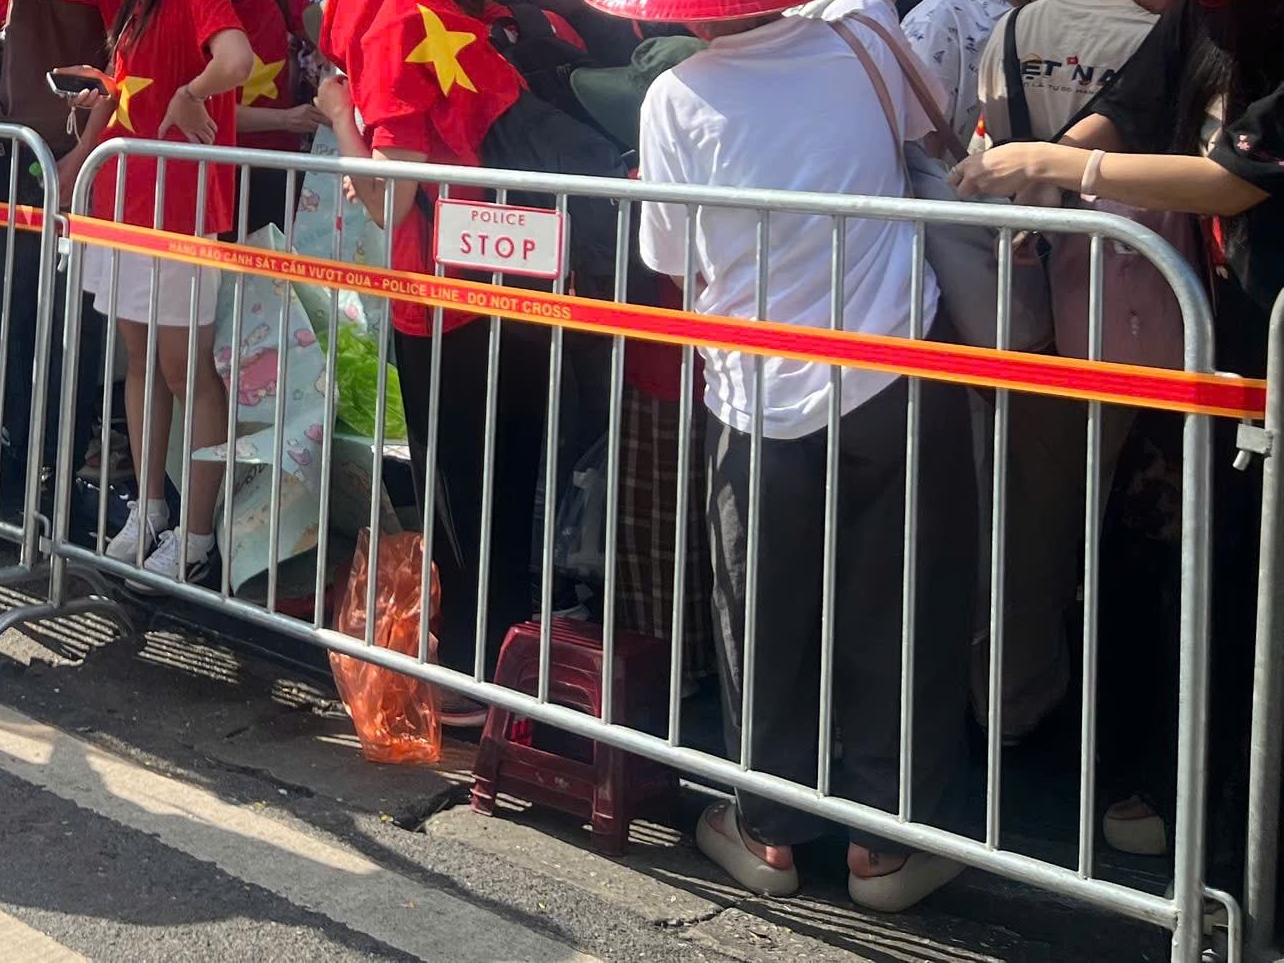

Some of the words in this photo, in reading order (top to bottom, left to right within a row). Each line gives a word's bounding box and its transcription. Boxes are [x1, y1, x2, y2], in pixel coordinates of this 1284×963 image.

[471, 210, 525, 226] POLICE
[459, 231, 536, 261] STOP
[169, 240, 197, 258] HÀNG
[199, 245, 223, 262] RÀO
[224, 249, 253, 266] CẢNH
[280, 256, 306, 276] CẤM
[308, 266, 344, 283] VƯỢT
[346, 272, 372, 288] QUA
[382, 278, 427, 297] POLICE
[467, 292, 487, 306] DO
[490, 295, 518, 311] NOT
[522, 301, 572, 320] CROSS
